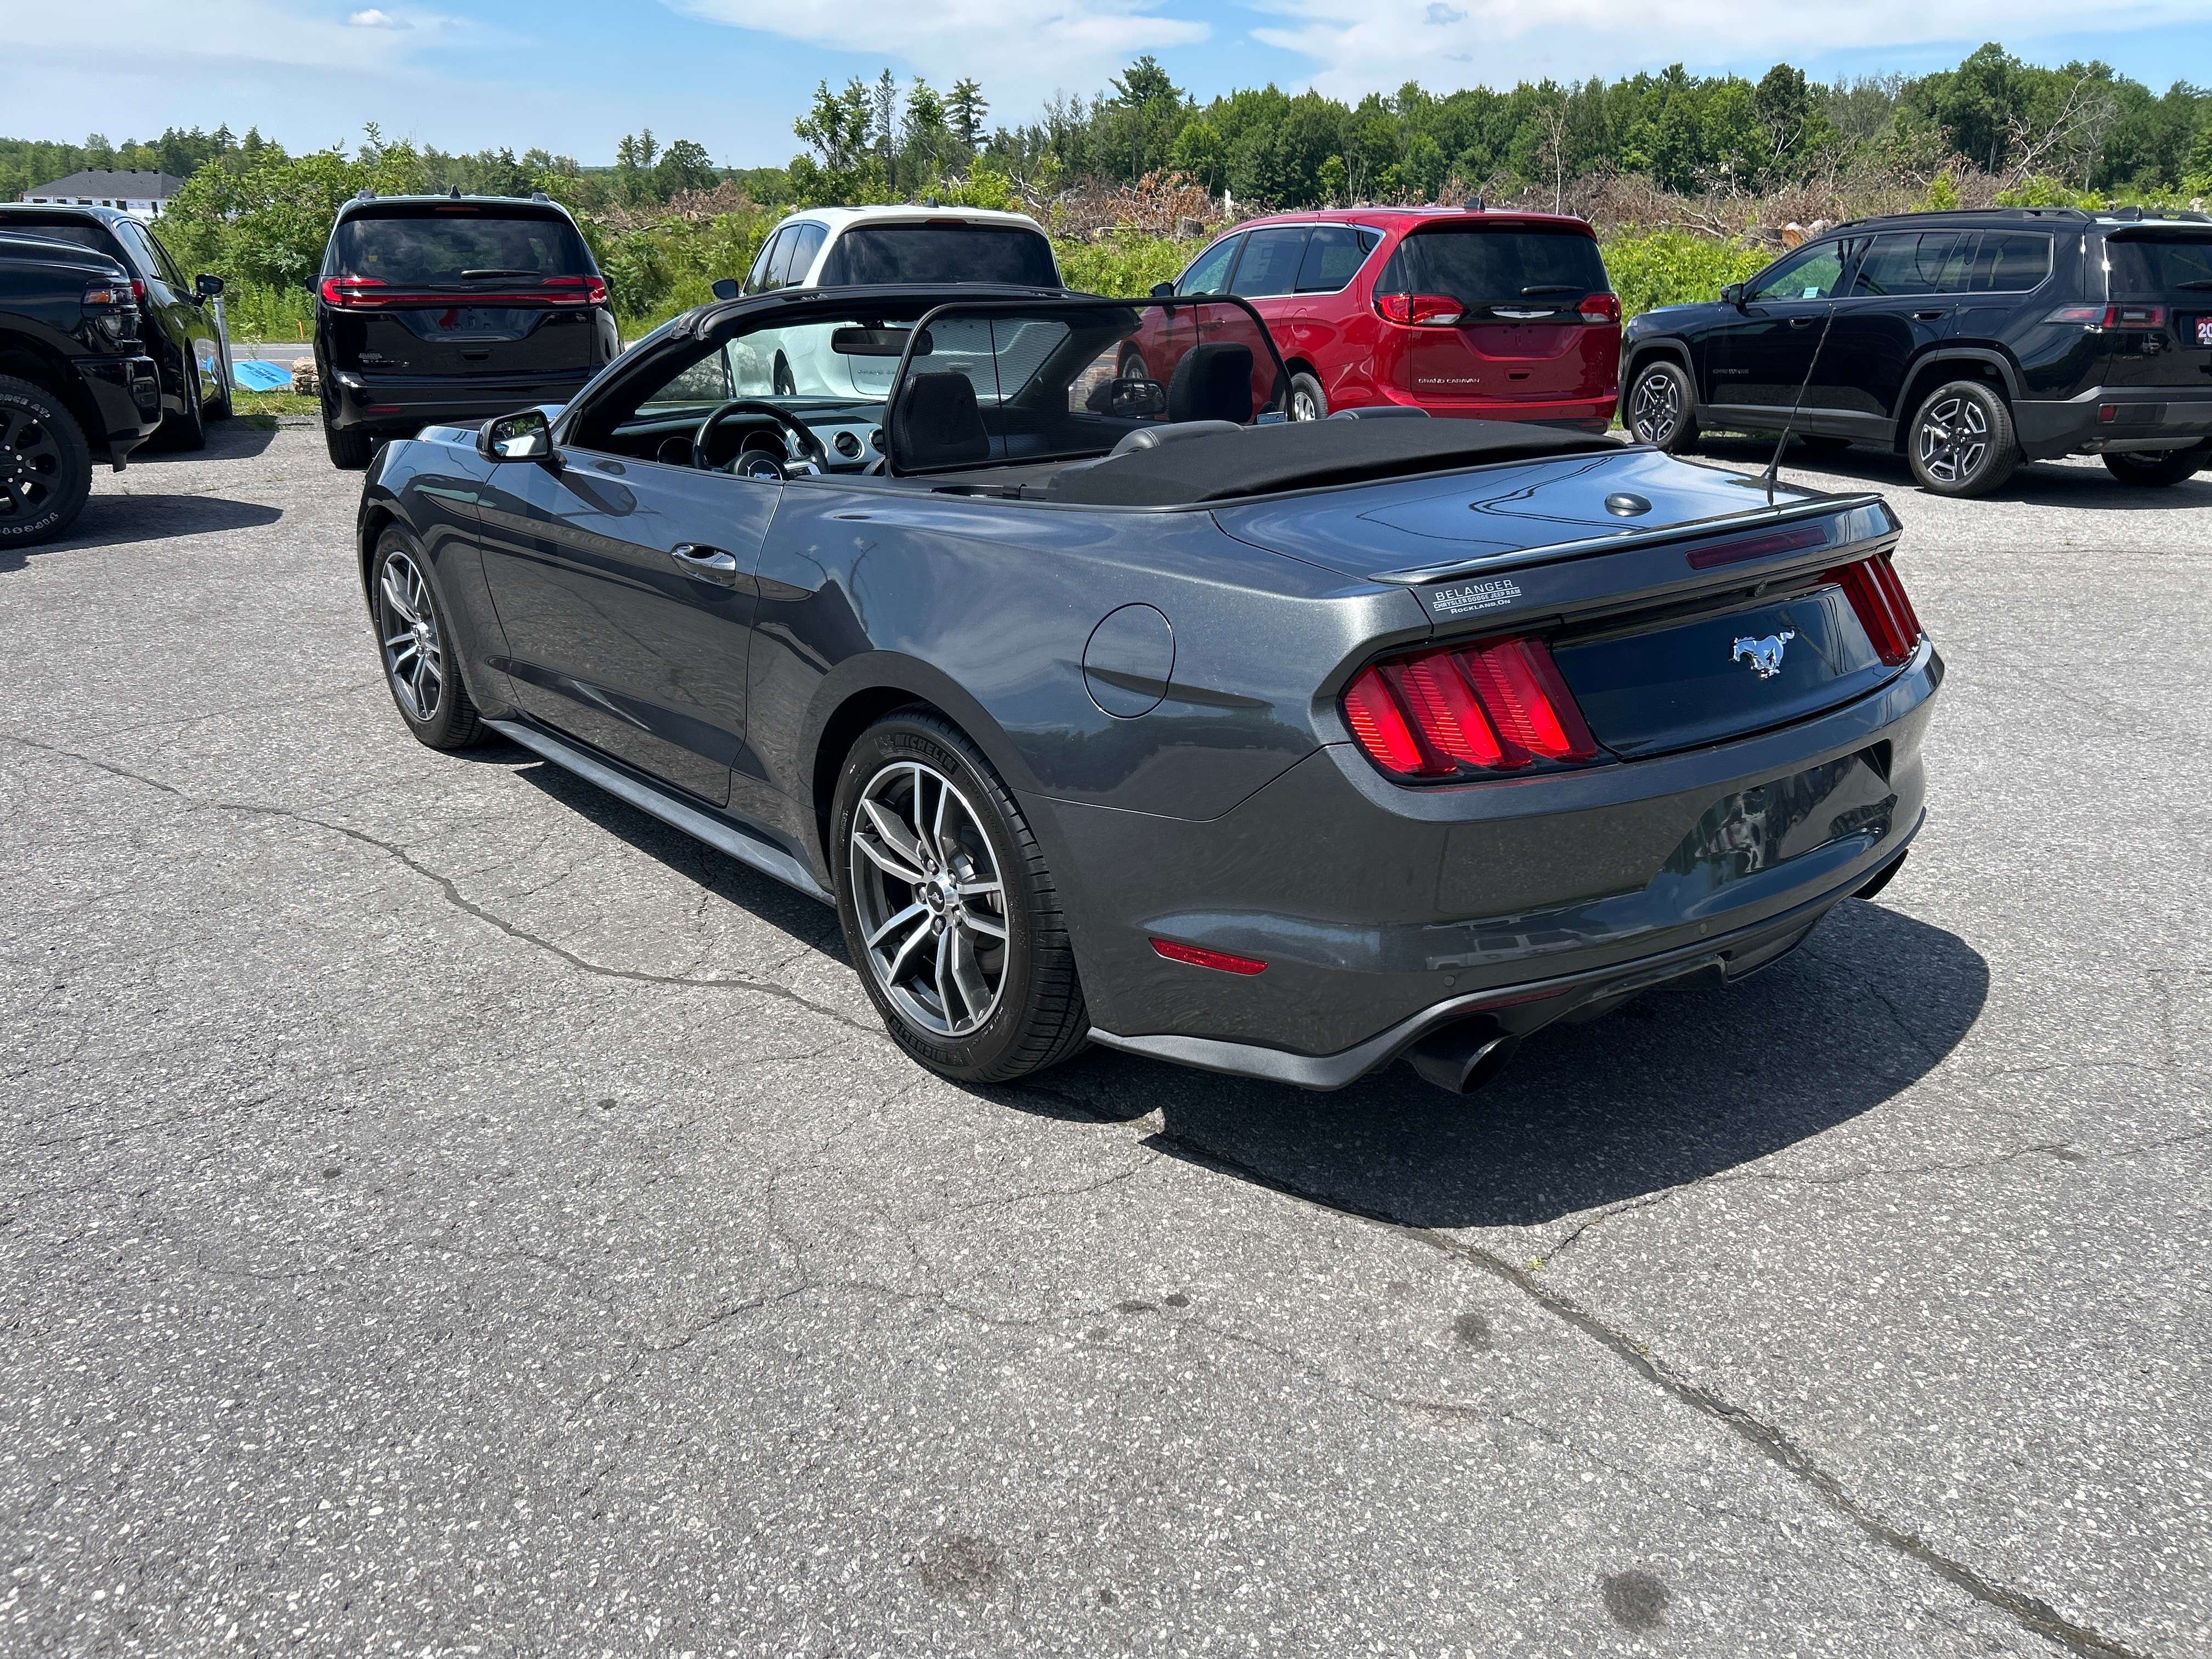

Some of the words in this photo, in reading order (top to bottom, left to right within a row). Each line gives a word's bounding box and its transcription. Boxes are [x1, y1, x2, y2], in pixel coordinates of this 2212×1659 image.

[1433, 598, 1466, 609] CHRYSLER
[1466, 594, 1489, 604] DODGE
[1490, 591, 1505, 599] JEEP
[1435, 579, 1514, 601] BELANGER
[895, 735, 956, 771] MICHELIN
[889, 1018, 948, 1063] MICHELIN
